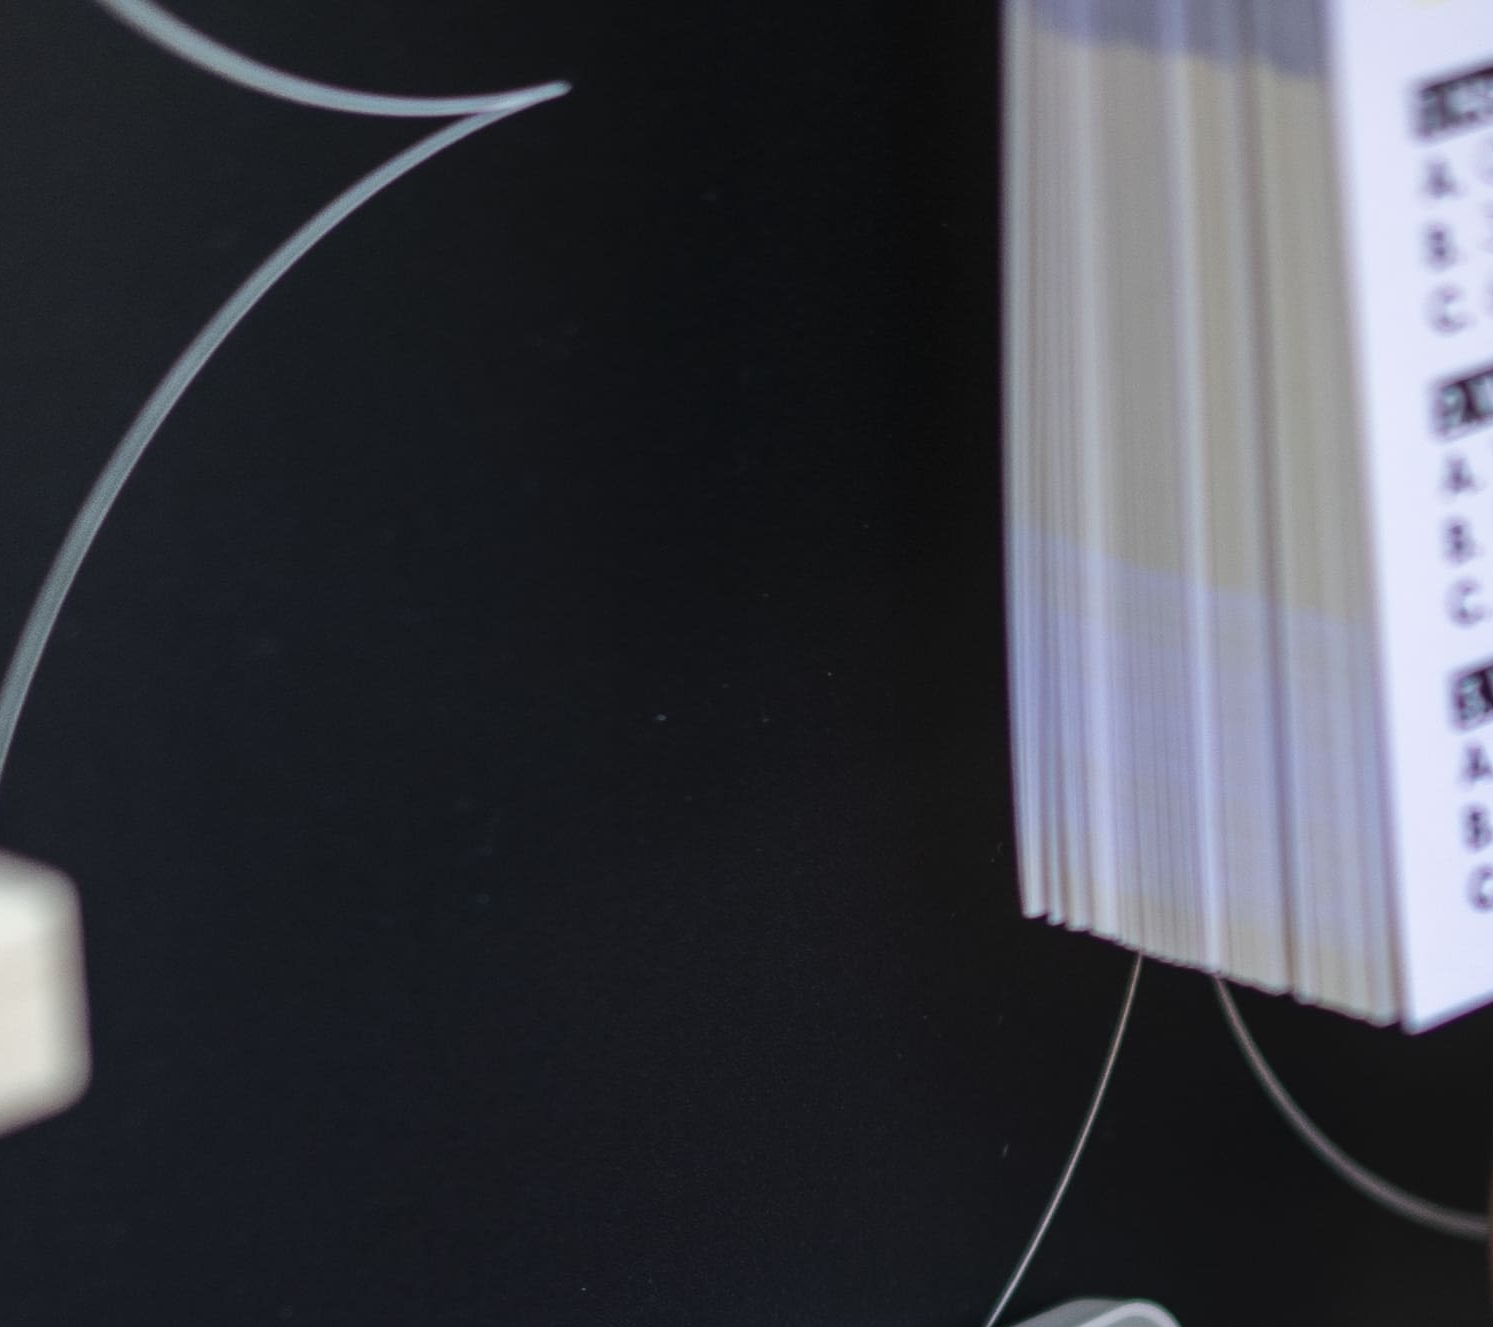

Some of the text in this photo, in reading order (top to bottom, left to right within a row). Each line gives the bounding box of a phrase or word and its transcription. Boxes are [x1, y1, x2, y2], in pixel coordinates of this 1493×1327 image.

[1424, 154, 1461, 199] A.
[1425, 222, 1459, 270] B.
[1426, 285, 1474, 335] C.
[1441, 454, 1484, 496] A.
[1443, 516, 1482, 565] B.
[1445, 577, 1492, 629] C.
